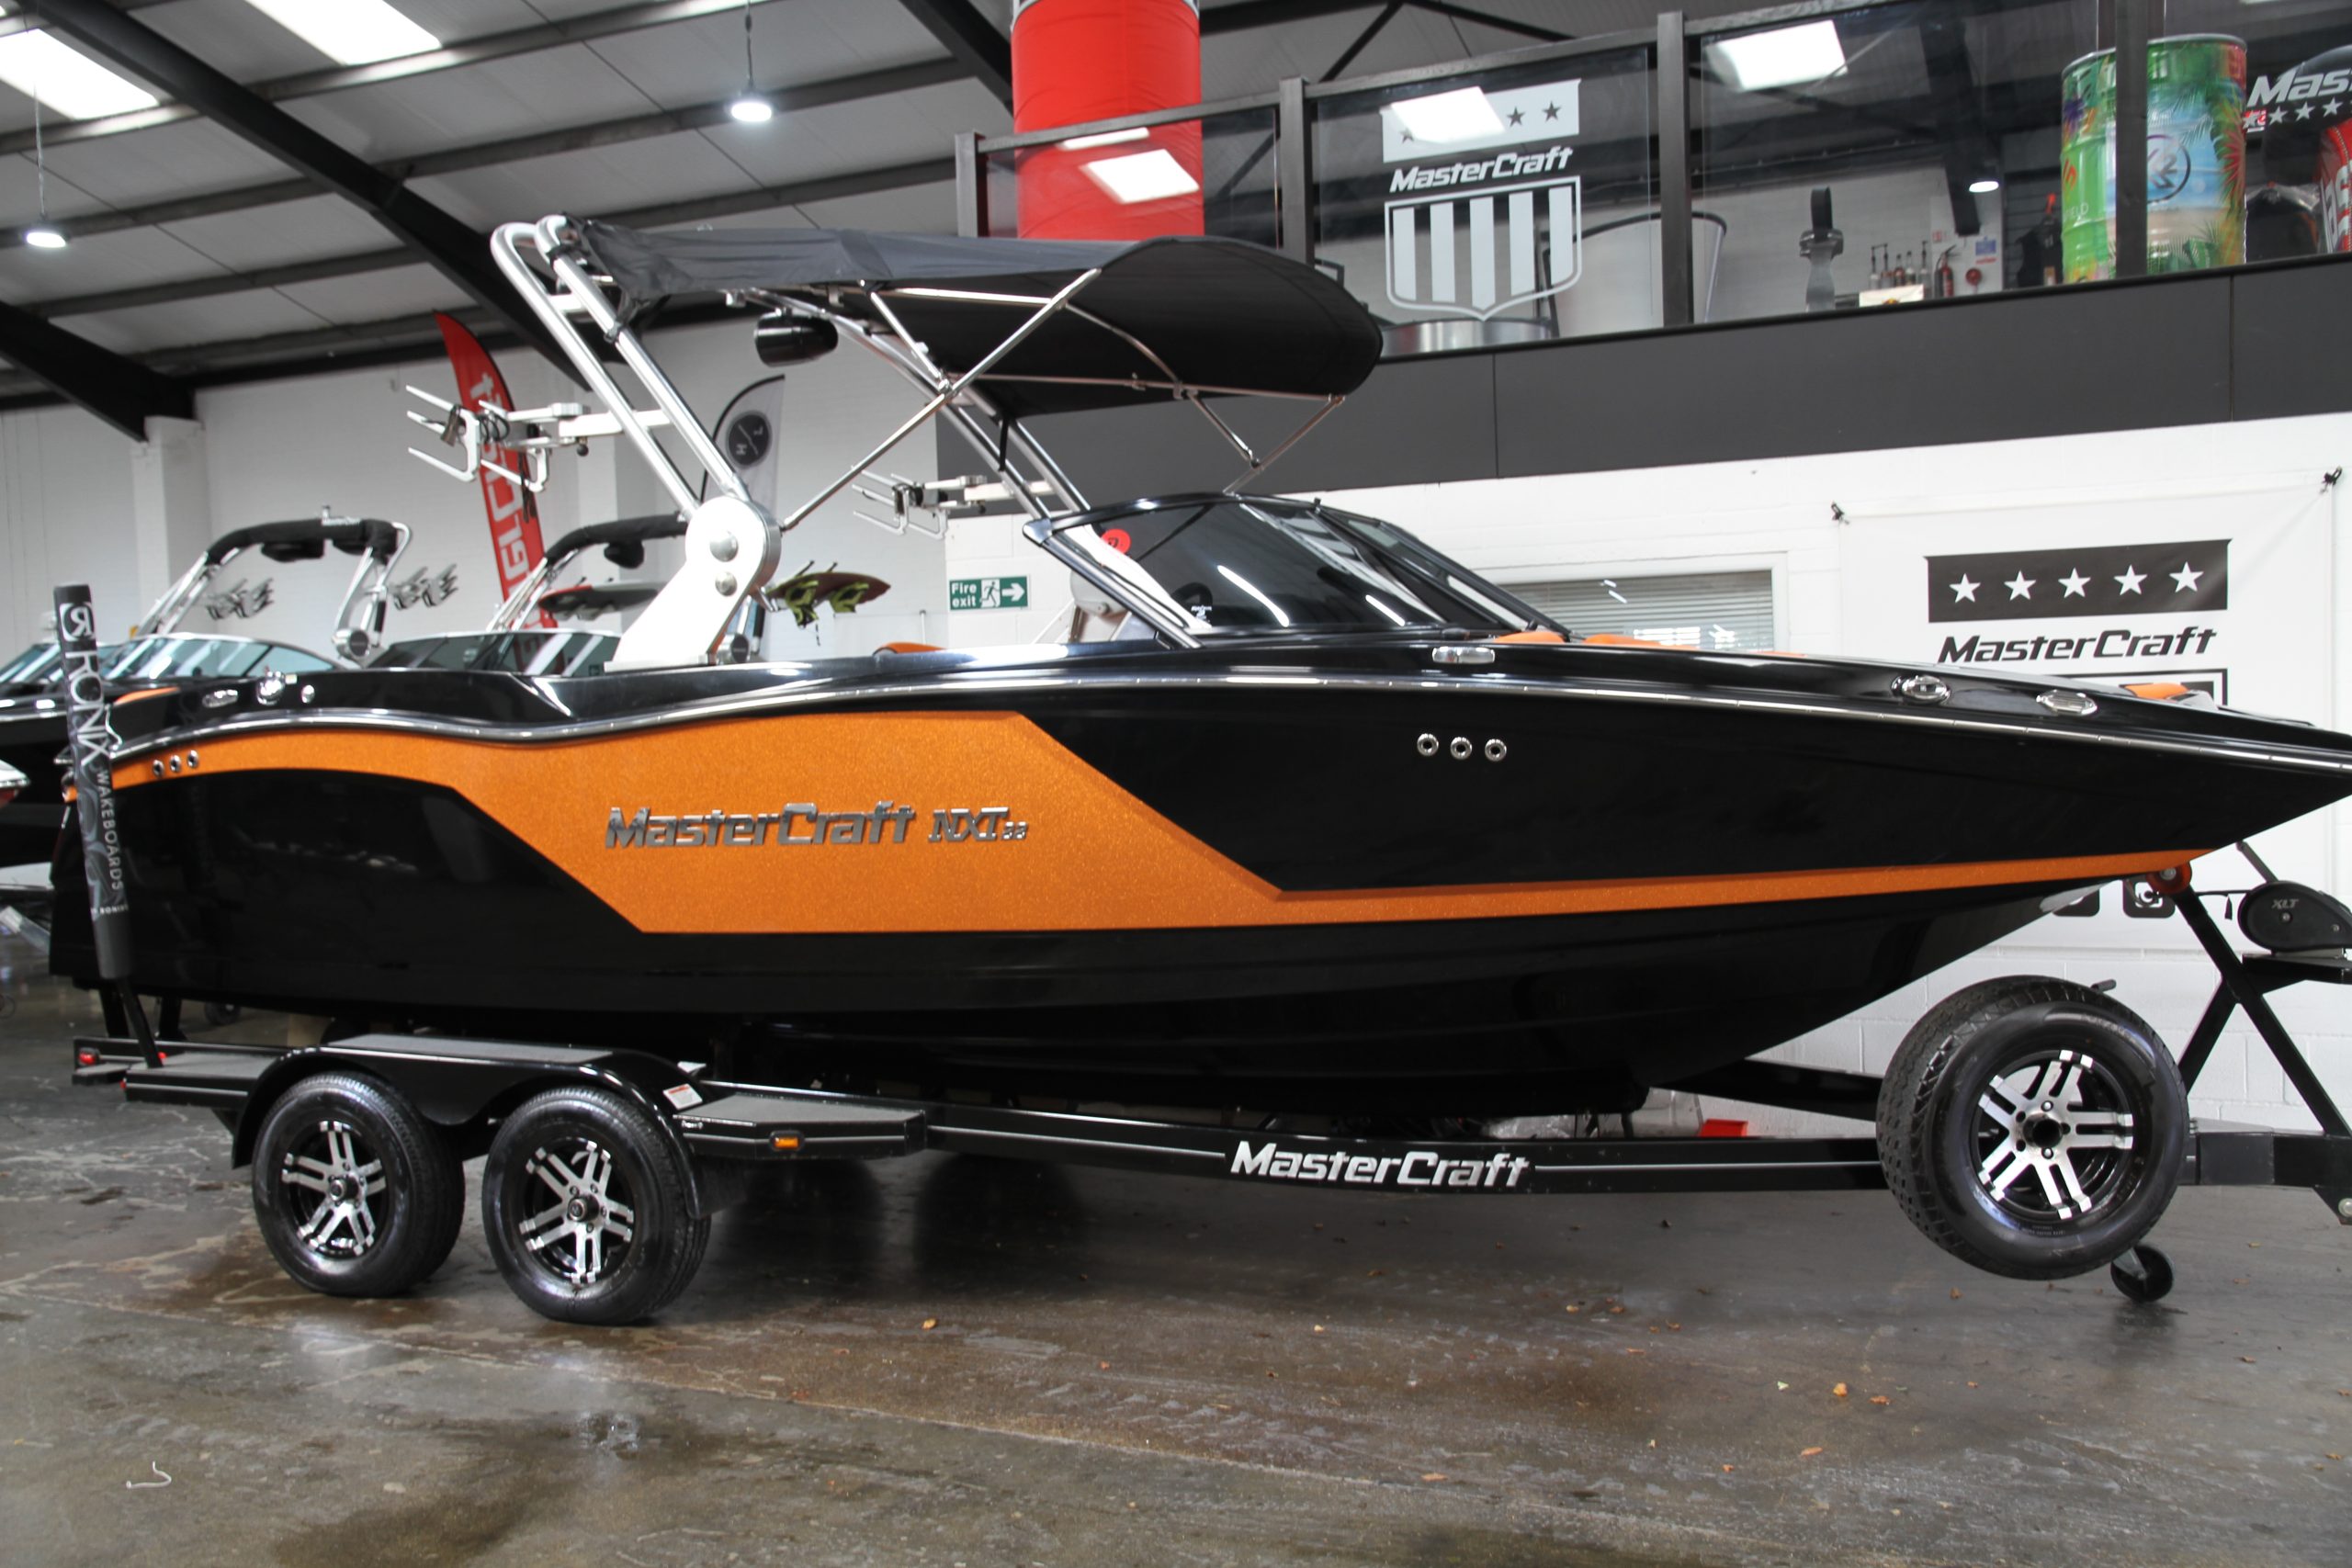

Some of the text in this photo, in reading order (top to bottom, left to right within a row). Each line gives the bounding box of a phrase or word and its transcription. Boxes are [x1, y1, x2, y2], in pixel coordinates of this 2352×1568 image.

[2246, 67, 2352, 108] Mas
[1388, 144, 1574, 193] MasterCraft
[951, 581, 978, 595] Fire
[951, 594, 977, 608] exit
[1937, 626, 2218, 663] MasterCraft
[64, 650, 111, 766] RONIX
[96, 770, 125, 890] WAKEBOARDS
[605, 800, 916, 848] MasterCraft
[2271, 898, 2300, 910] XLT
[1230, 1140, 1530, 1187] MasterCraft
